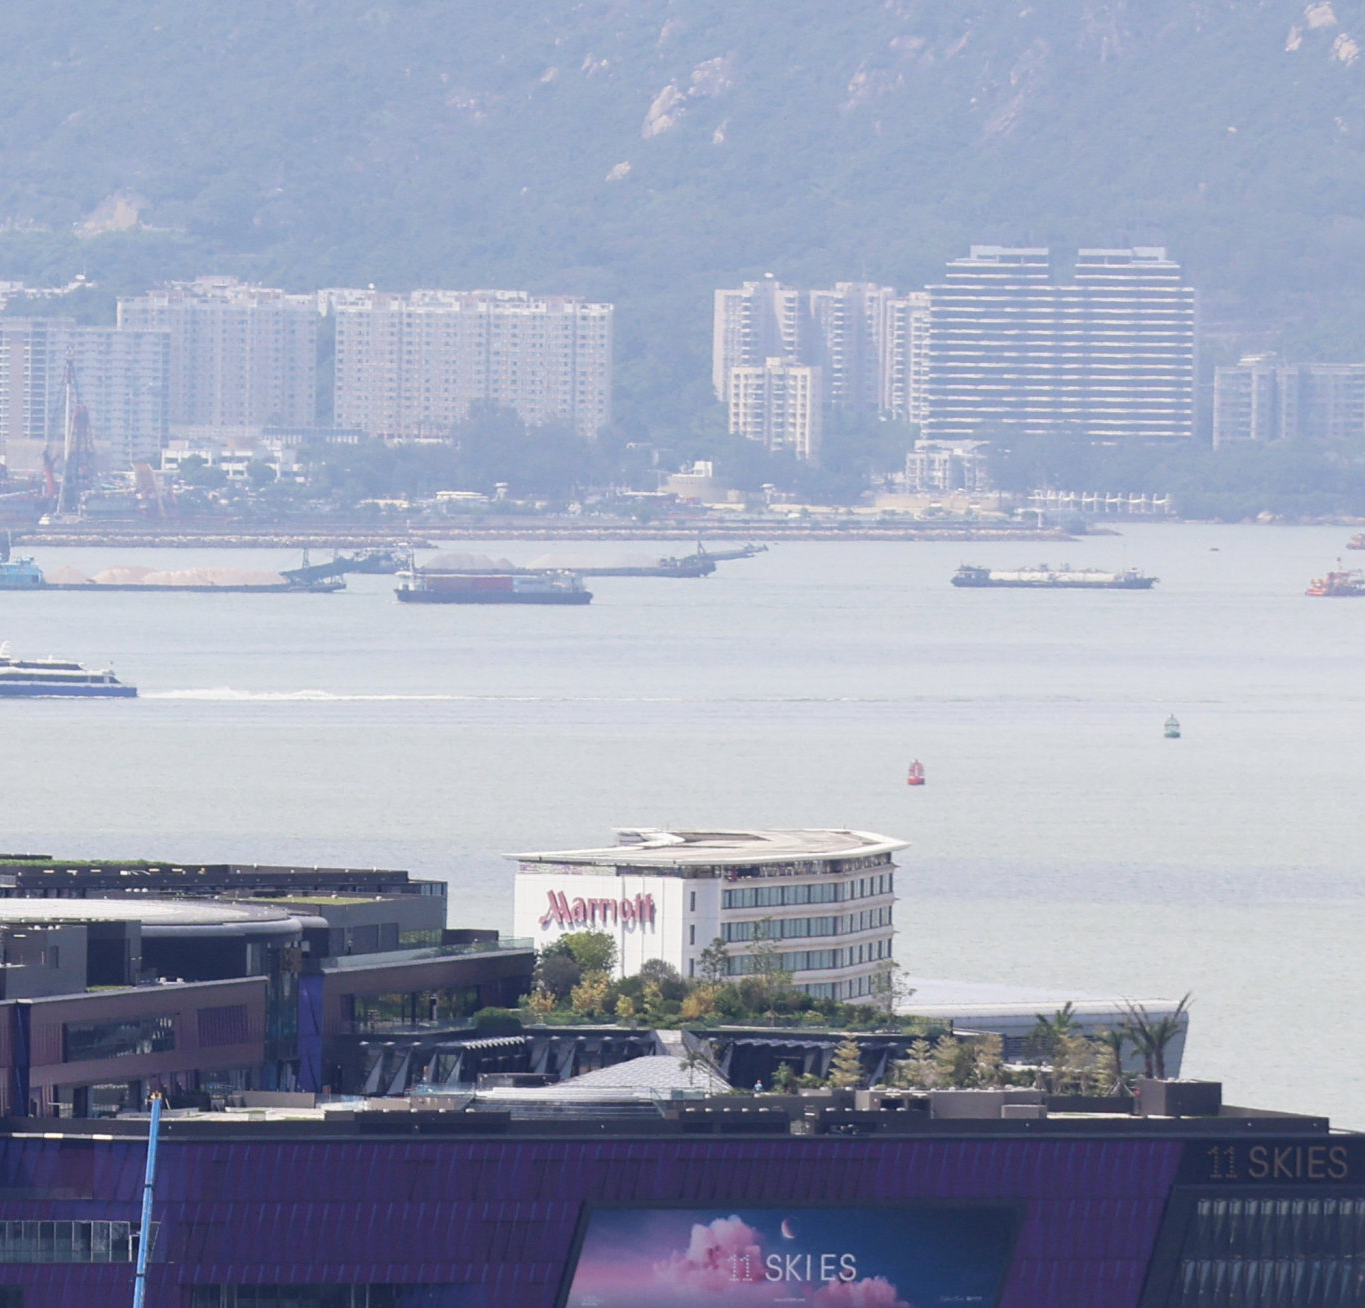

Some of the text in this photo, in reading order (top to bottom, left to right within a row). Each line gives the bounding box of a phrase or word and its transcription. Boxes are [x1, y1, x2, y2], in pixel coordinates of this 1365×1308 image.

[538, 889, 655, 924] Marriott
[1207, 1145, 1348, 1179] 11 SKIES
[727, 1253, 857, 1282] 11 SKIES
